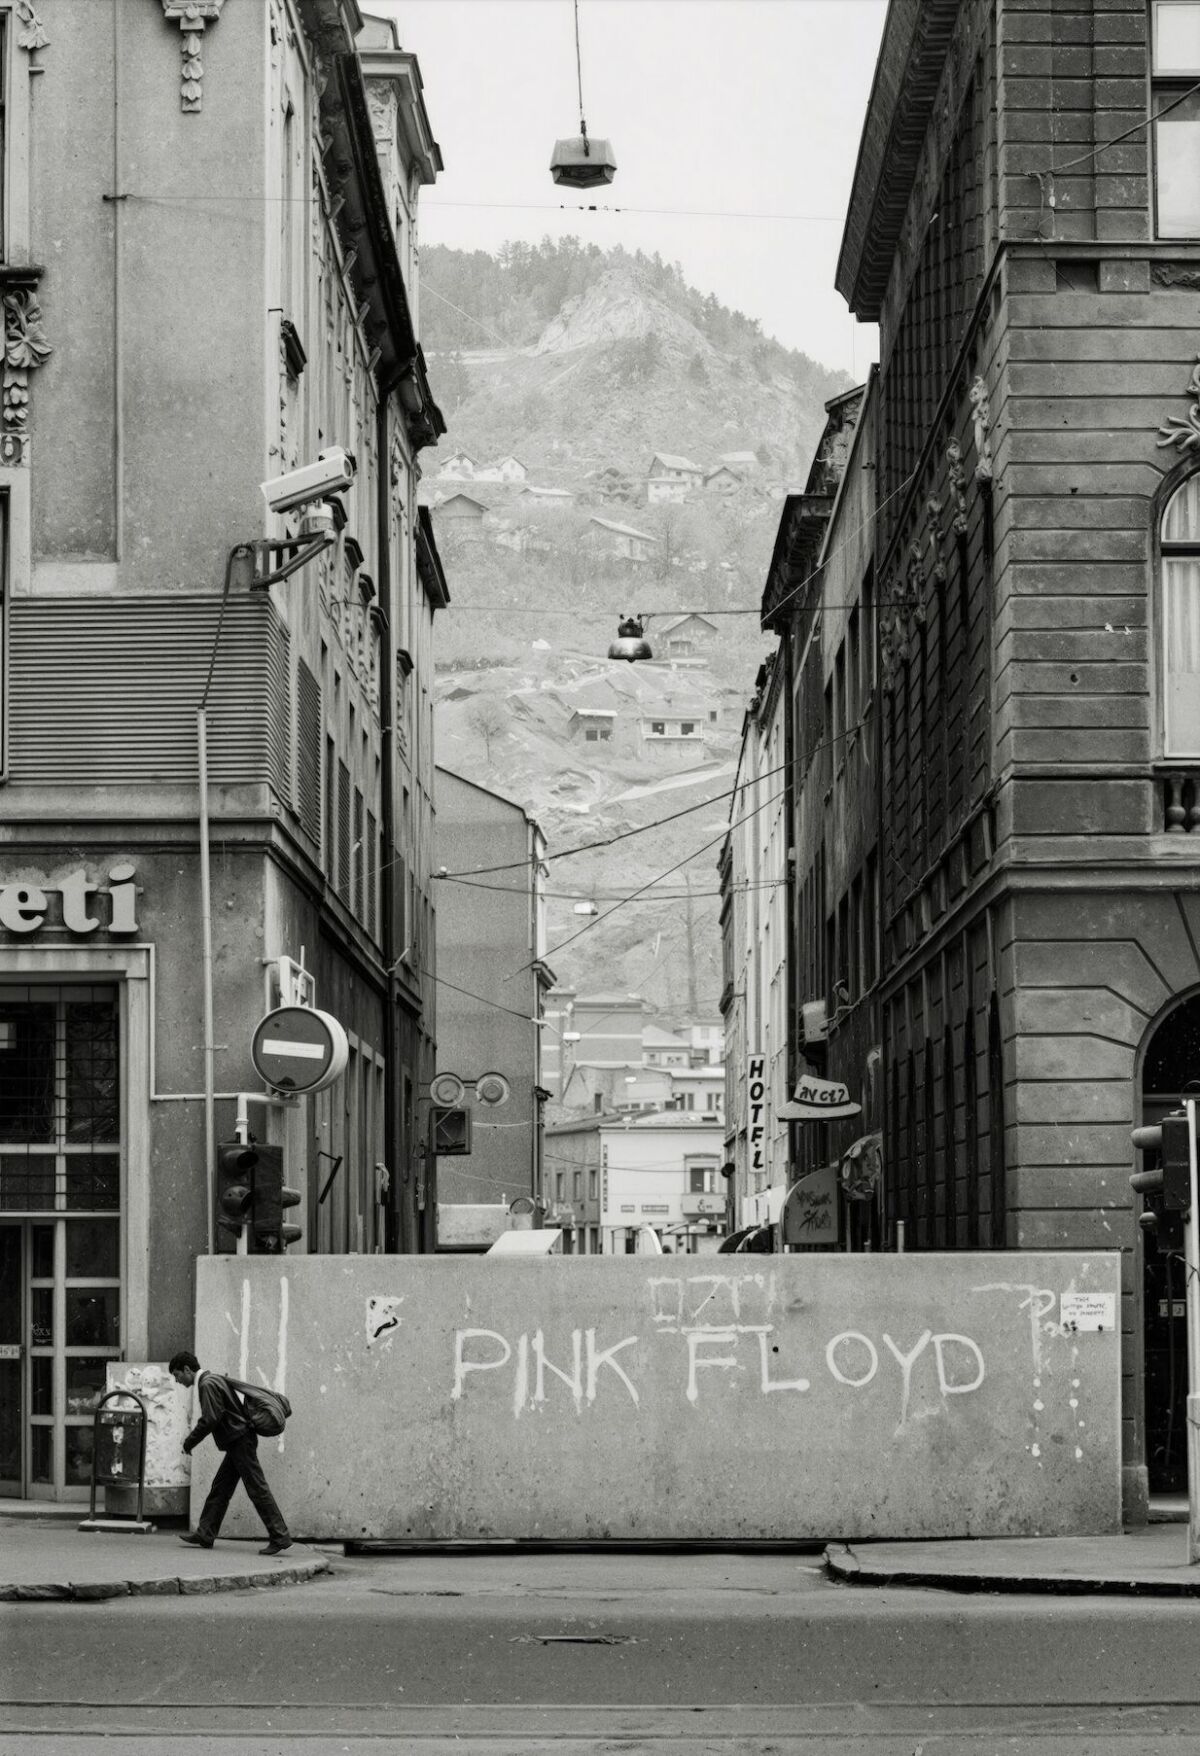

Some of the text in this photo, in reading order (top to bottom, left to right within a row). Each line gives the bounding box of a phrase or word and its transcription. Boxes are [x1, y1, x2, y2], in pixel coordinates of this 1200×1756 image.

[0, 864, 139, 933] eti
[451, 1328, 640, 1420] PINK
[685, 1330, 985, 1432] FLOYD
